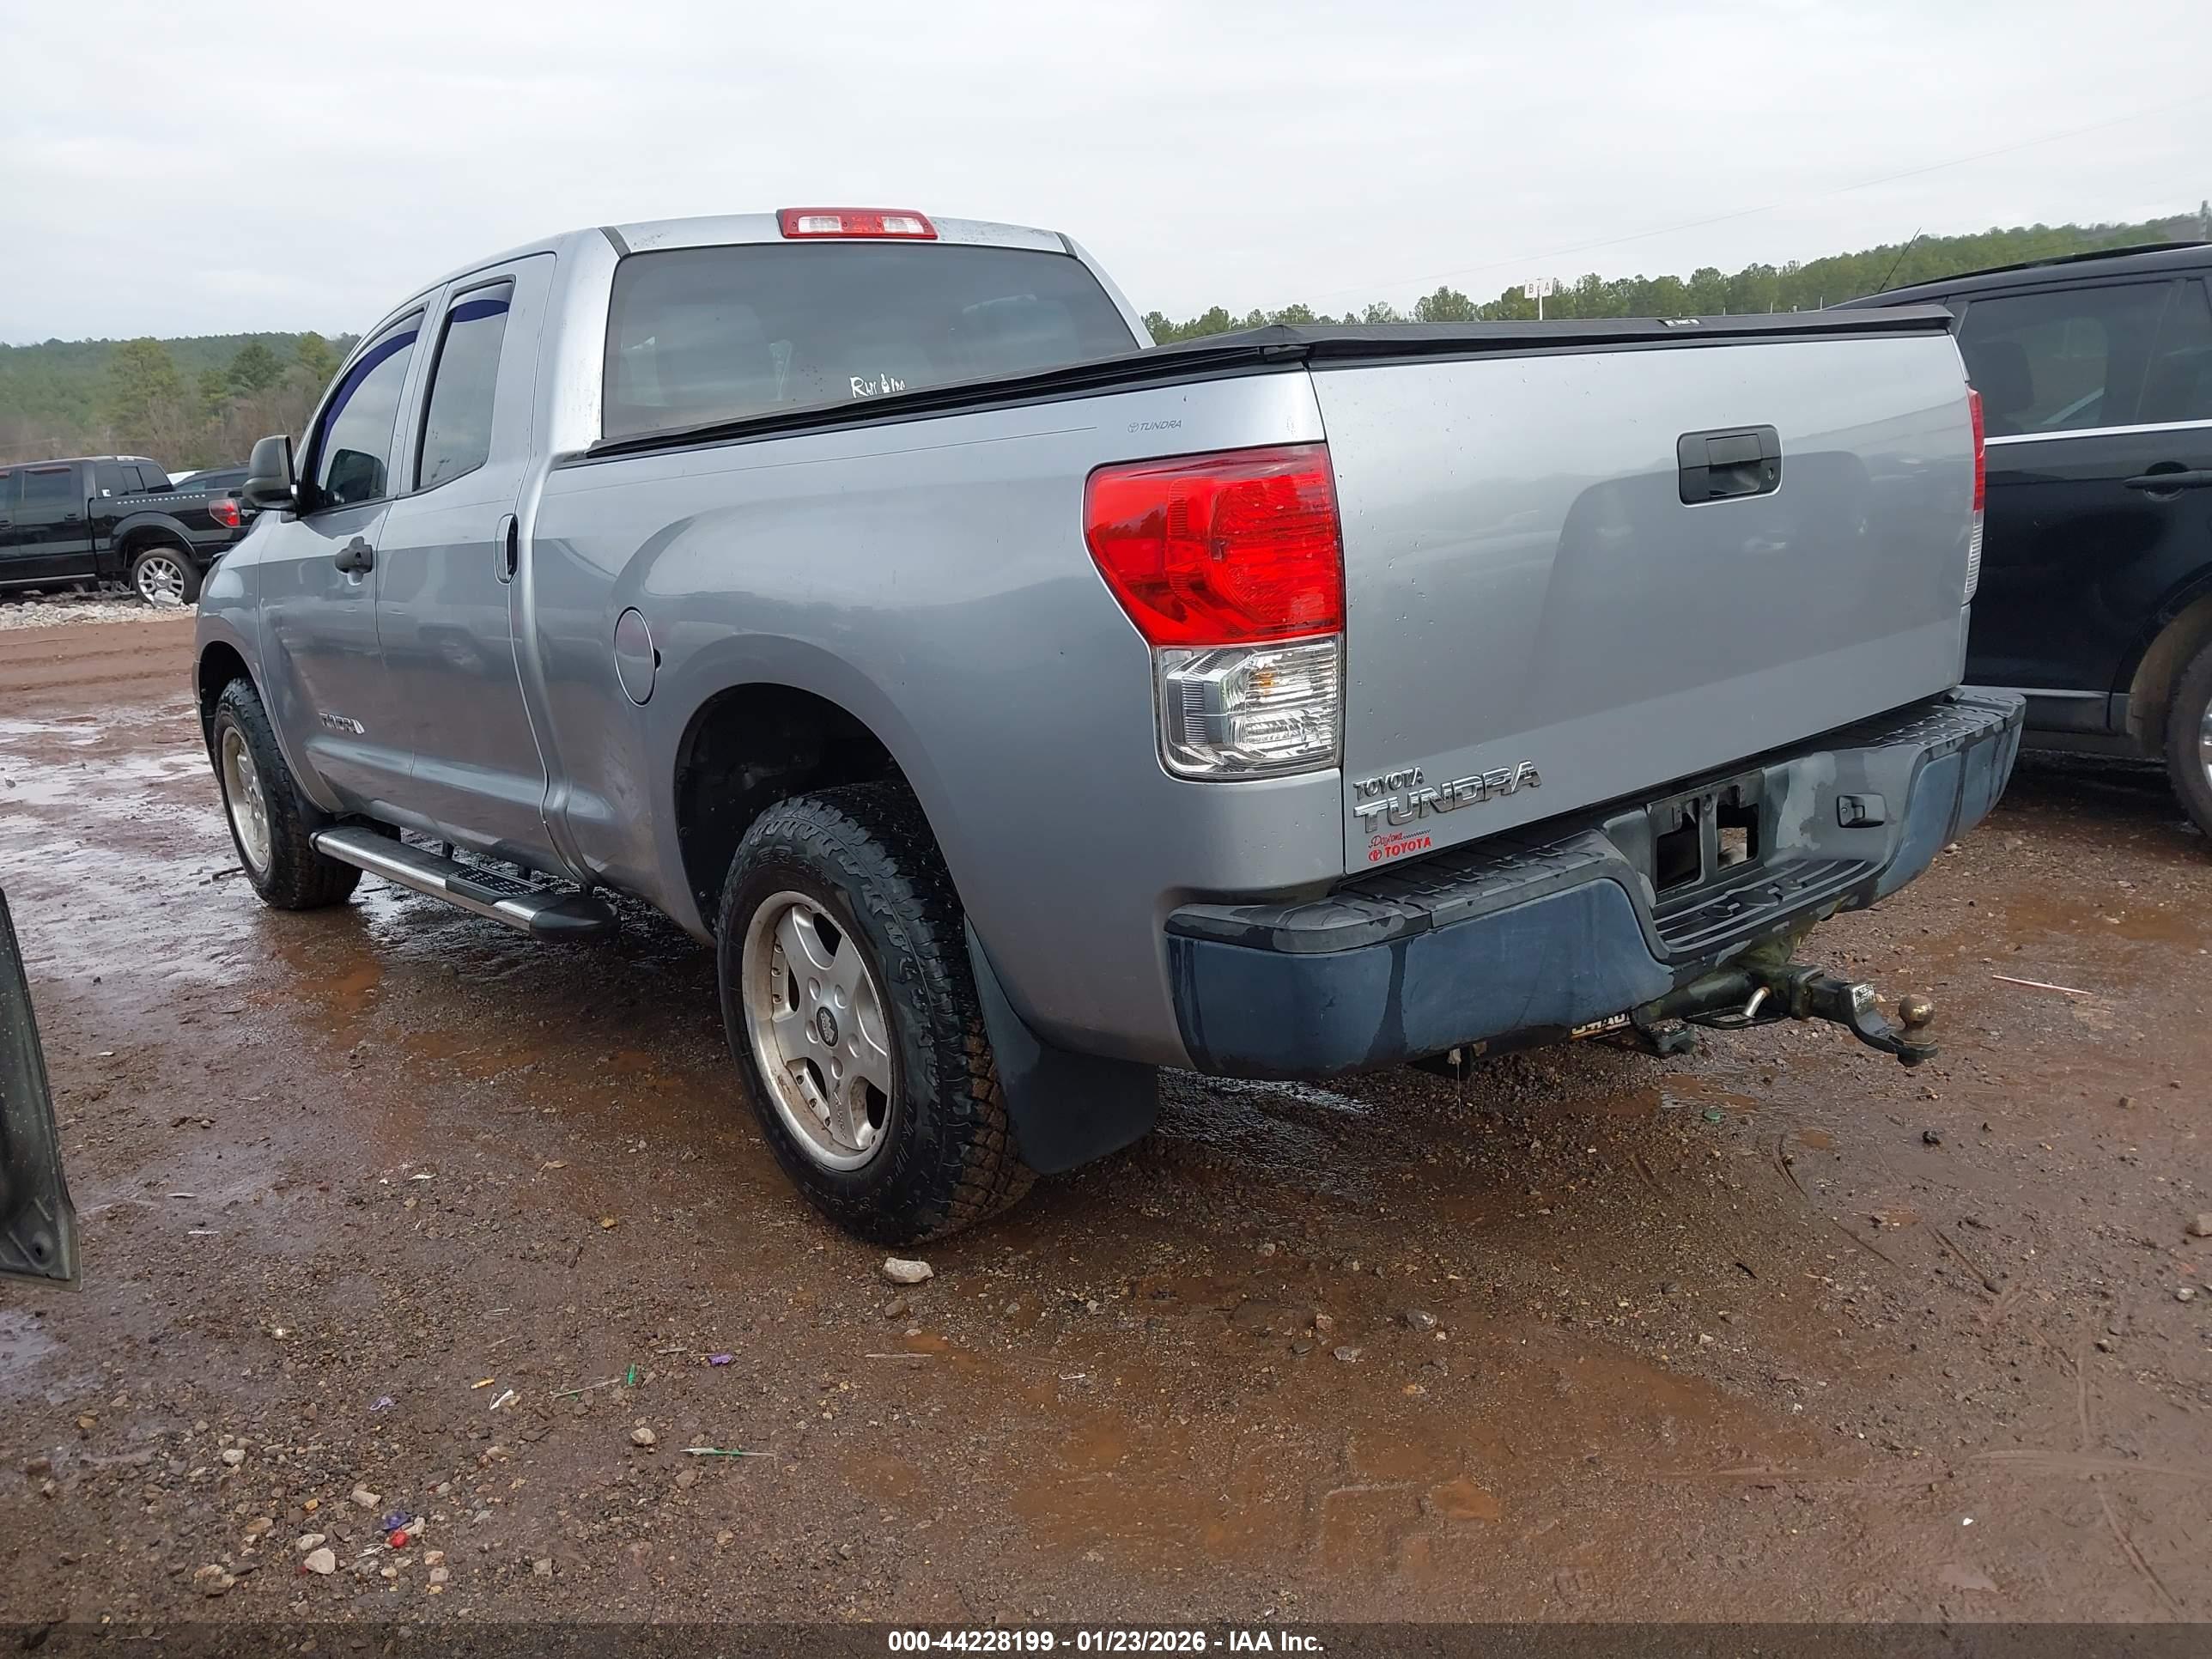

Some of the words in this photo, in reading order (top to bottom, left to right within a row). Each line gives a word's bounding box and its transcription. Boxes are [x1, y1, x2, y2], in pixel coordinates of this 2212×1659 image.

[1139, 420, 1182, 431] TUNDRA
[1353, 767, 1425, 800] TOYOTA
[1353, 759, 1542, 833] TUNDRA
[1384, 836, 1431, 858] TOYOTA
